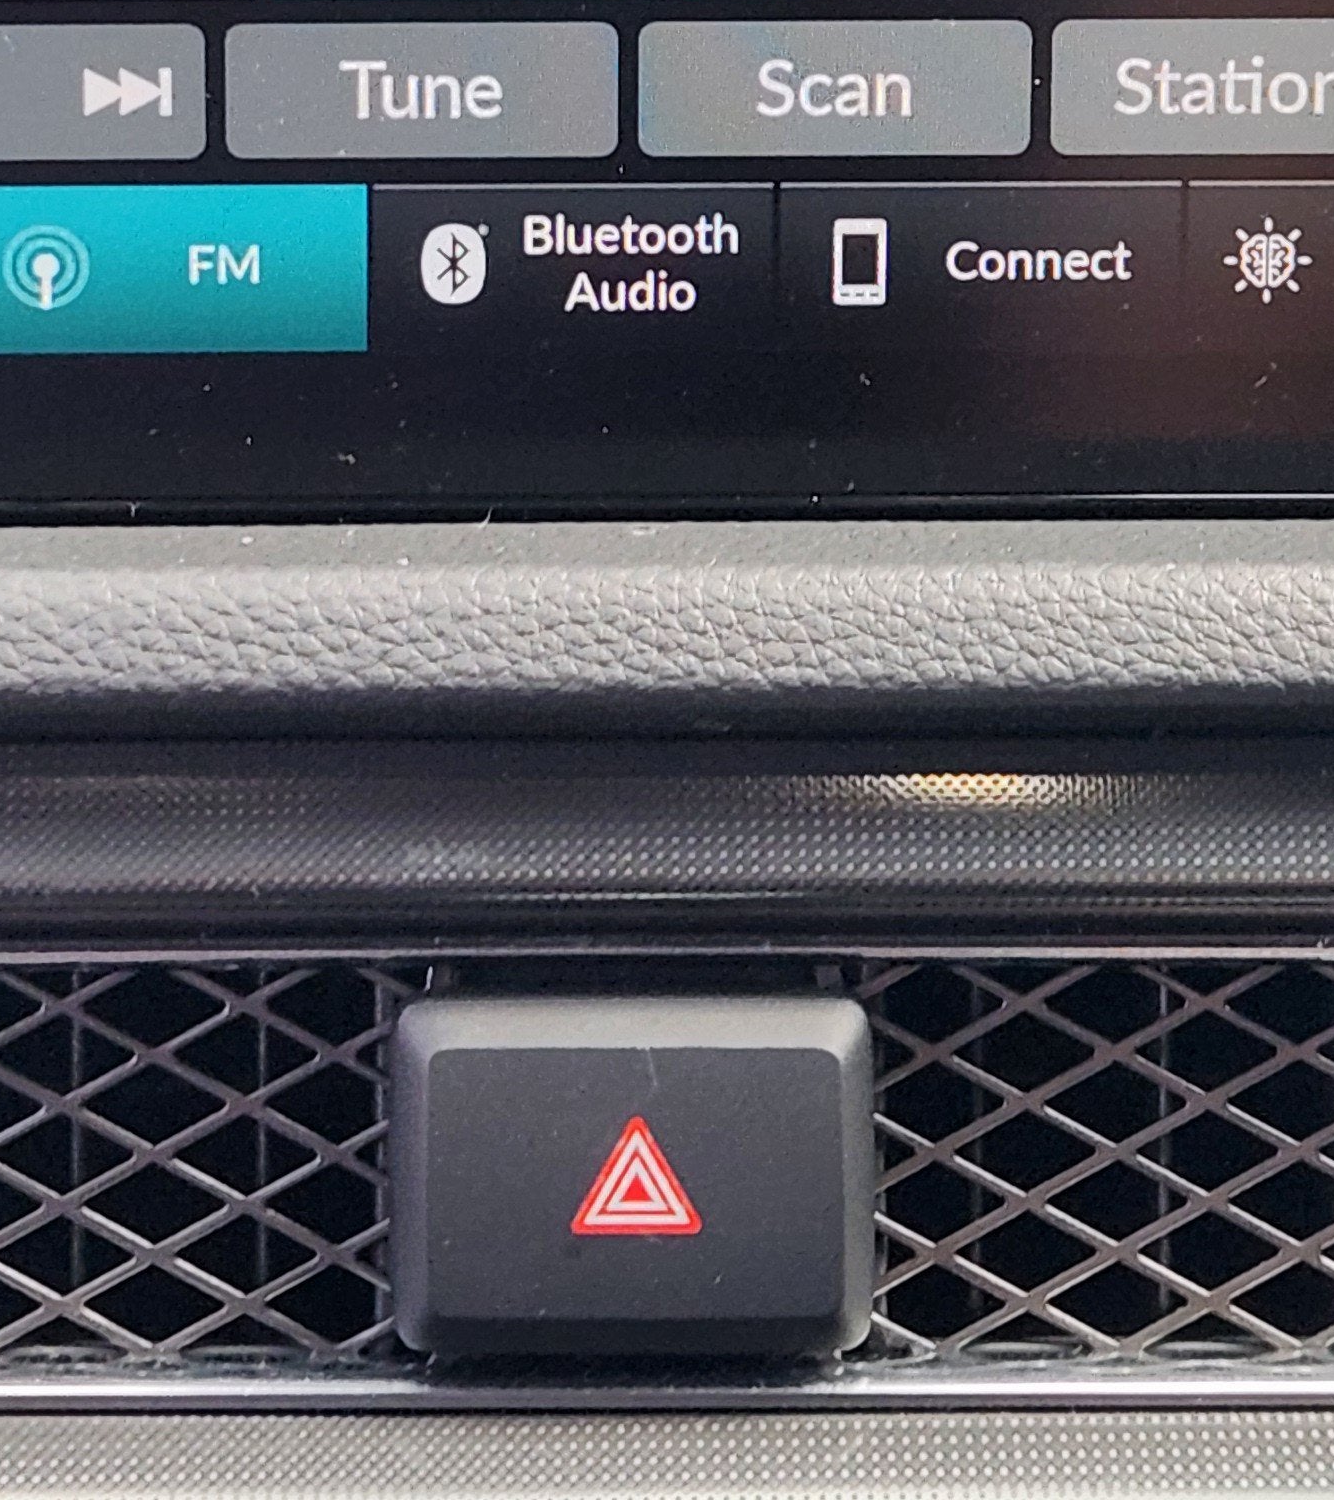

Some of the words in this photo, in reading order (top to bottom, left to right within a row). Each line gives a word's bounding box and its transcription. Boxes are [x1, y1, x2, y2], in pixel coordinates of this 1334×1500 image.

[338, 59, 503, 120] Tune
[756, 59, 912, 117] Scan
[523, 212, 739, 256] Bluetooth
[188, 244, 260, 286] FM
[946, 240, 1132, 281] Connect
[564, 269, 697, 312] Audio
